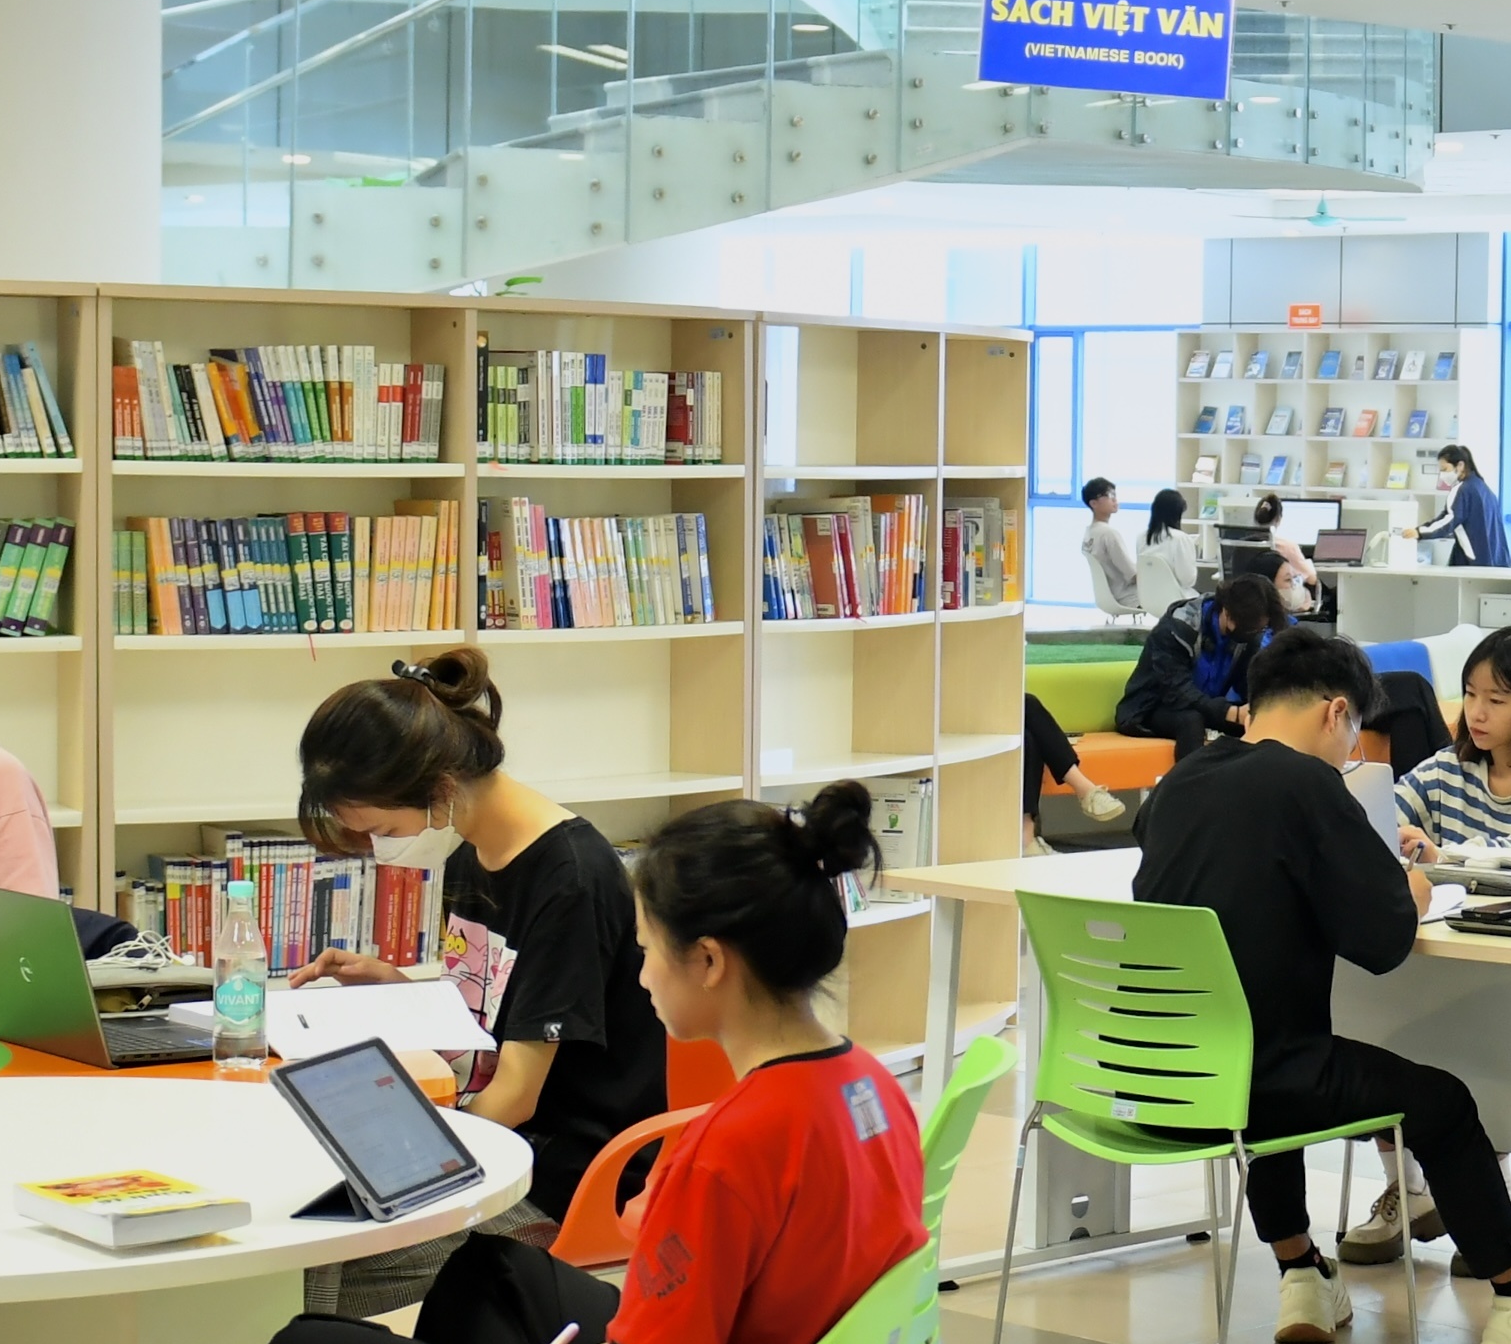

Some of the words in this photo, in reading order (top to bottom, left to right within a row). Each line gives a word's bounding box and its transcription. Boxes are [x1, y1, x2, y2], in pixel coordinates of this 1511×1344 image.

[1082, 0, 1150, 36] VIỆT
[1156, 5, 1224, 39] VĂN
[1025, 42, 1130, 65] (VIETNAMESE
[1133, 50, 1185, 70] BOOK)
[217, 994, 260, 1005] VIVANT
